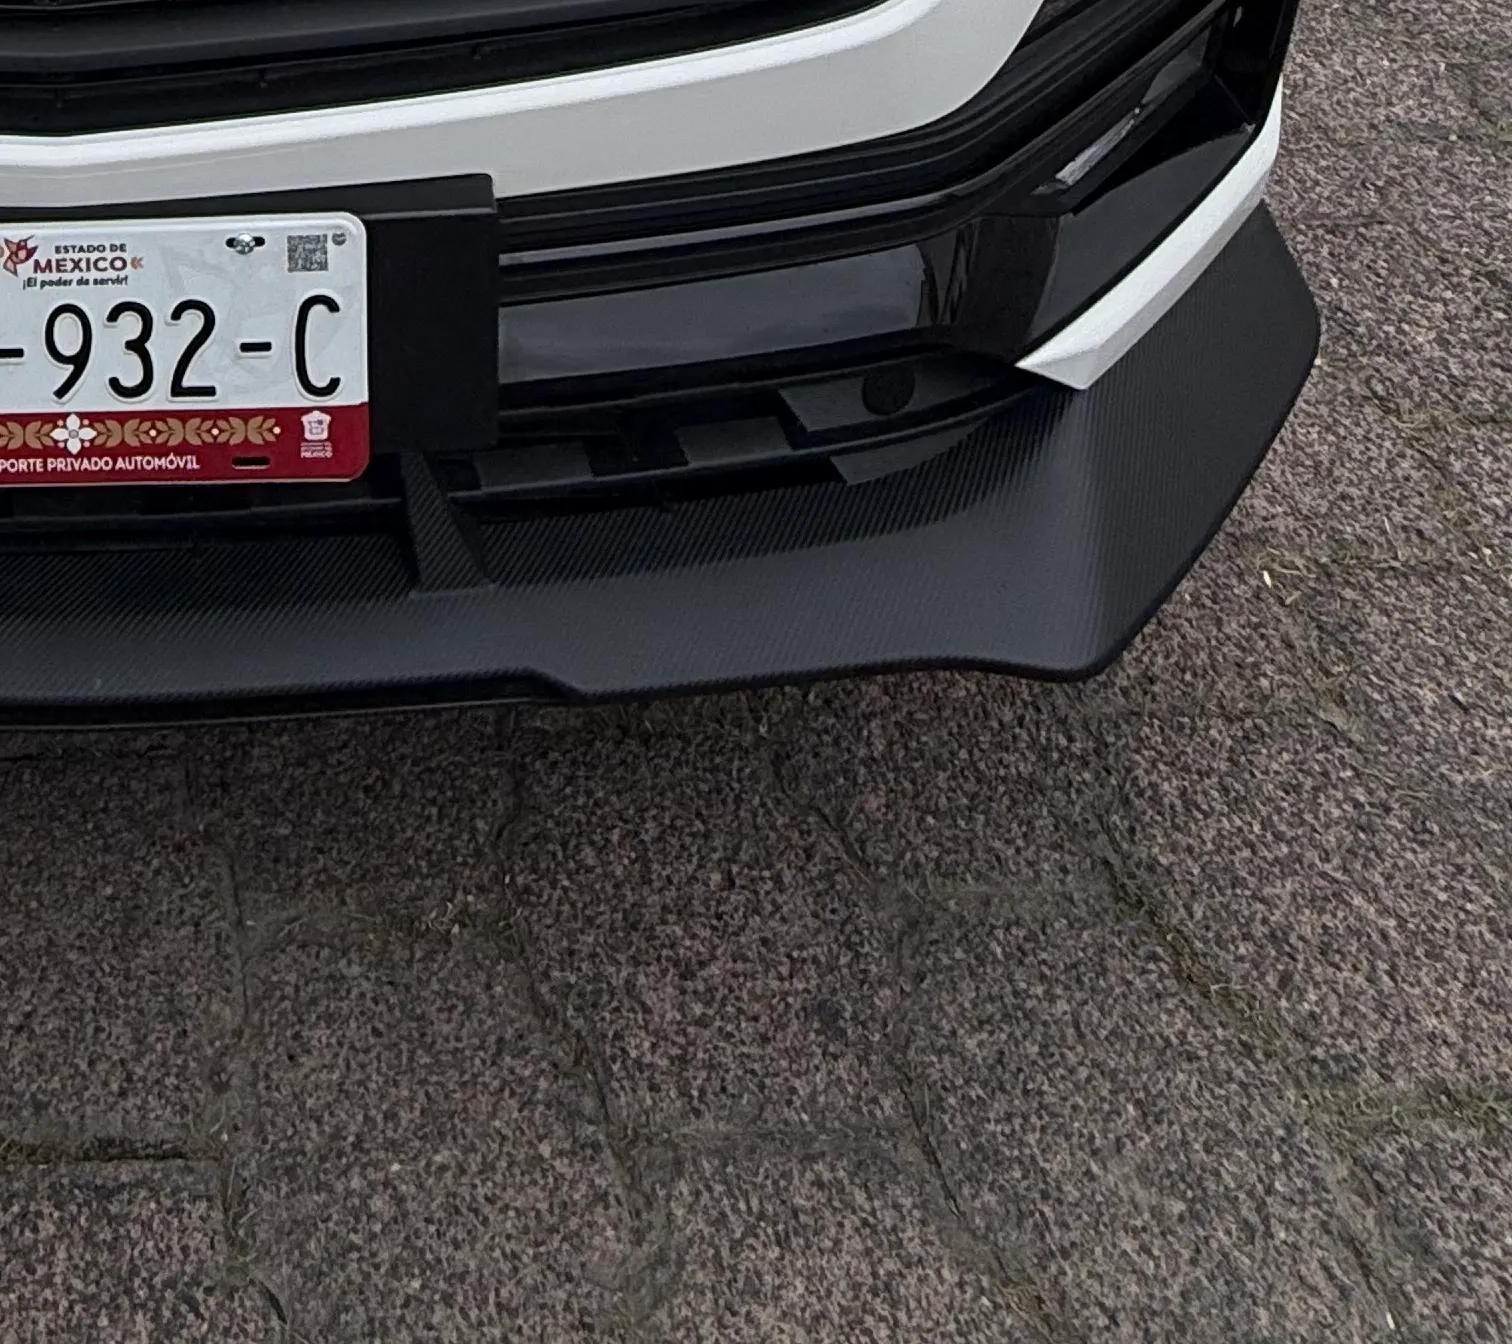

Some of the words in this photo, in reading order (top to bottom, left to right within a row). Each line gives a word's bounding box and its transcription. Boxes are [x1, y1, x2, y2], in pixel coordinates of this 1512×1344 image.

[54, 245, 105, 254] ESTADO
[109, 243, 127, 253] DE
[46, 456, 112, 472] PRIVADO
[115, 451, 200, 471] AUTOMÓVIL
